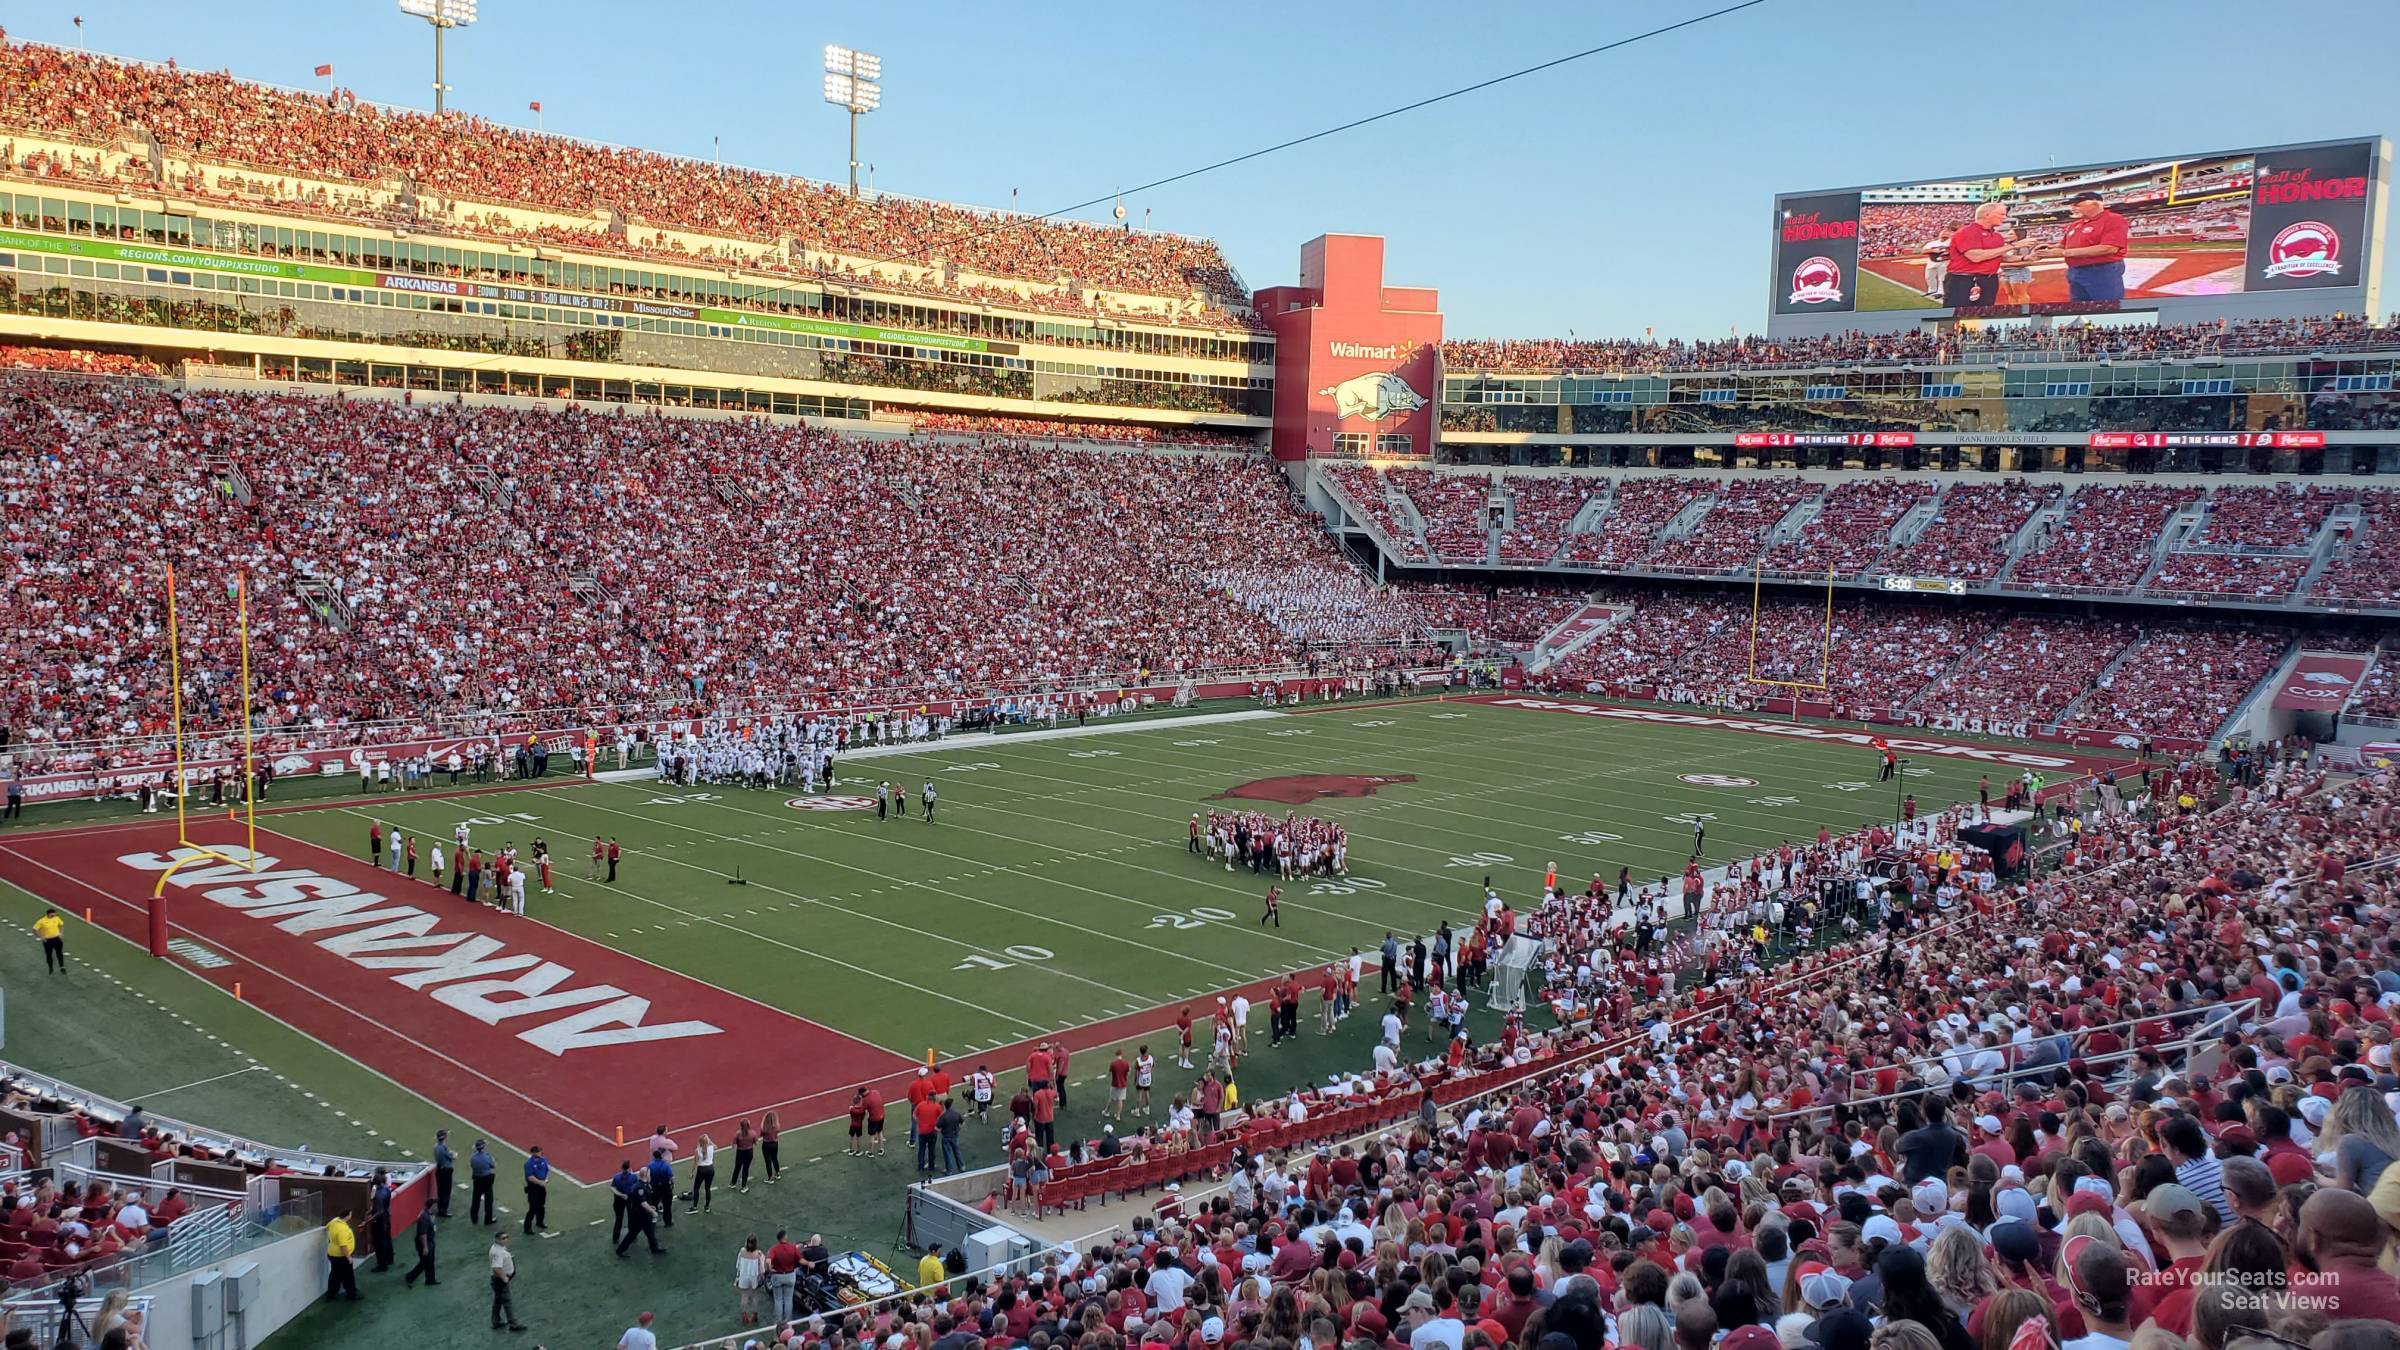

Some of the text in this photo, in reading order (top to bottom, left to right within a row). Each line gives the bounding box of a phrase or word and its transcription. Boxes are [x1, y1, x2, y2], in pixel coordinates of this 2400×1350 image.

[2292, 168, 2311, 182] of
[2257, 177, 2366, 205] HONOR
[1783, 221, 1857, 241] HONOR
[44, 241, 63, 250] THE
[120, 249, 280, 274] REGIONS.COM/YOURPIXSTUDIO
[384, 276, 457, 294] ARKANSAS
[503, 291, 509, 300] 3
[530, 293, 536, 302] 5
[580, 298, 589, 307] 25
[603, 300, 609, 309] 2
[1330, 340, 1397, 360] Walmart
[1955, 435, 2048, 443] FRANK BROYLES FIELD
[2244, 434, 2252, 445] 7
[1885, 578, 1912, 589] 15:00
[1949, 581, 1964, 593] 25
[2288, 686, 2343, 698] COX
[1490, 699, 2076, 767] RAZORBACKS
[466, 812, 545, 826] 10
[1562, 831, 1625, 846] 50
[1446, 851, 1515, 868] 40
[1310, 876, 1388, 896] 30
[1150, 907, 1238, 930] 20
[116, 844, 726, 1056] ARKANSAS
[960, 945, 1056, 971] 10
[1623, 960, 1636, 972] 70
